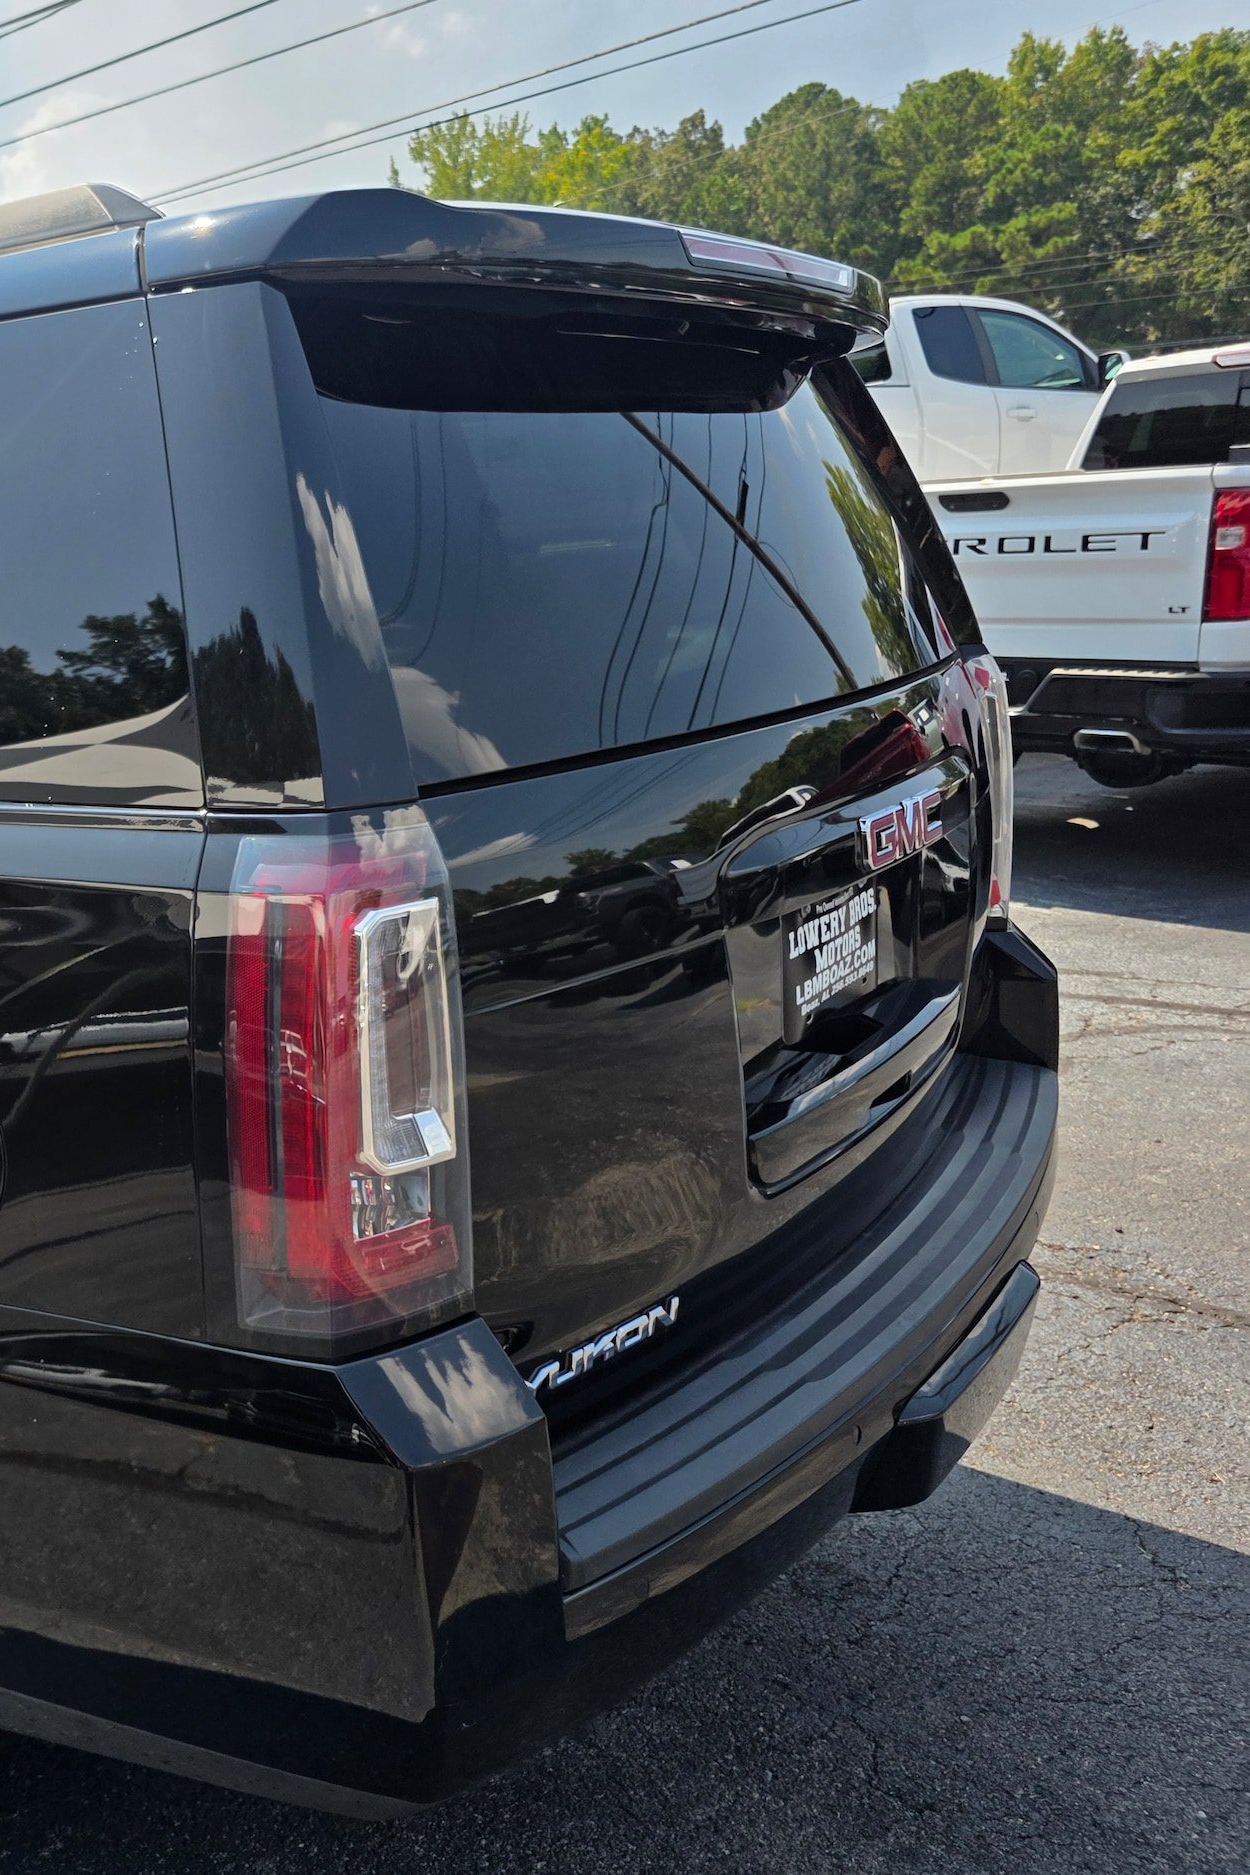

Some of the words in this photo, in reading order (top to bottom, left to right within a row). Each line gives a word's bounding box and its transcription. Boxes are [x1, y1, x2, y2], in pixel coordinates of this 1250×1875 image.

[952, 531, 1166, 555] ROLET
[862, 789, 943, 870] GMC
[788, 905, 847, 960] LOWERY
[848, 887, 877, 926] BROS.
[814, 924, 861, 974] MOTORS
[796, 938, 876, 1006] LBMBOAZ.COM
